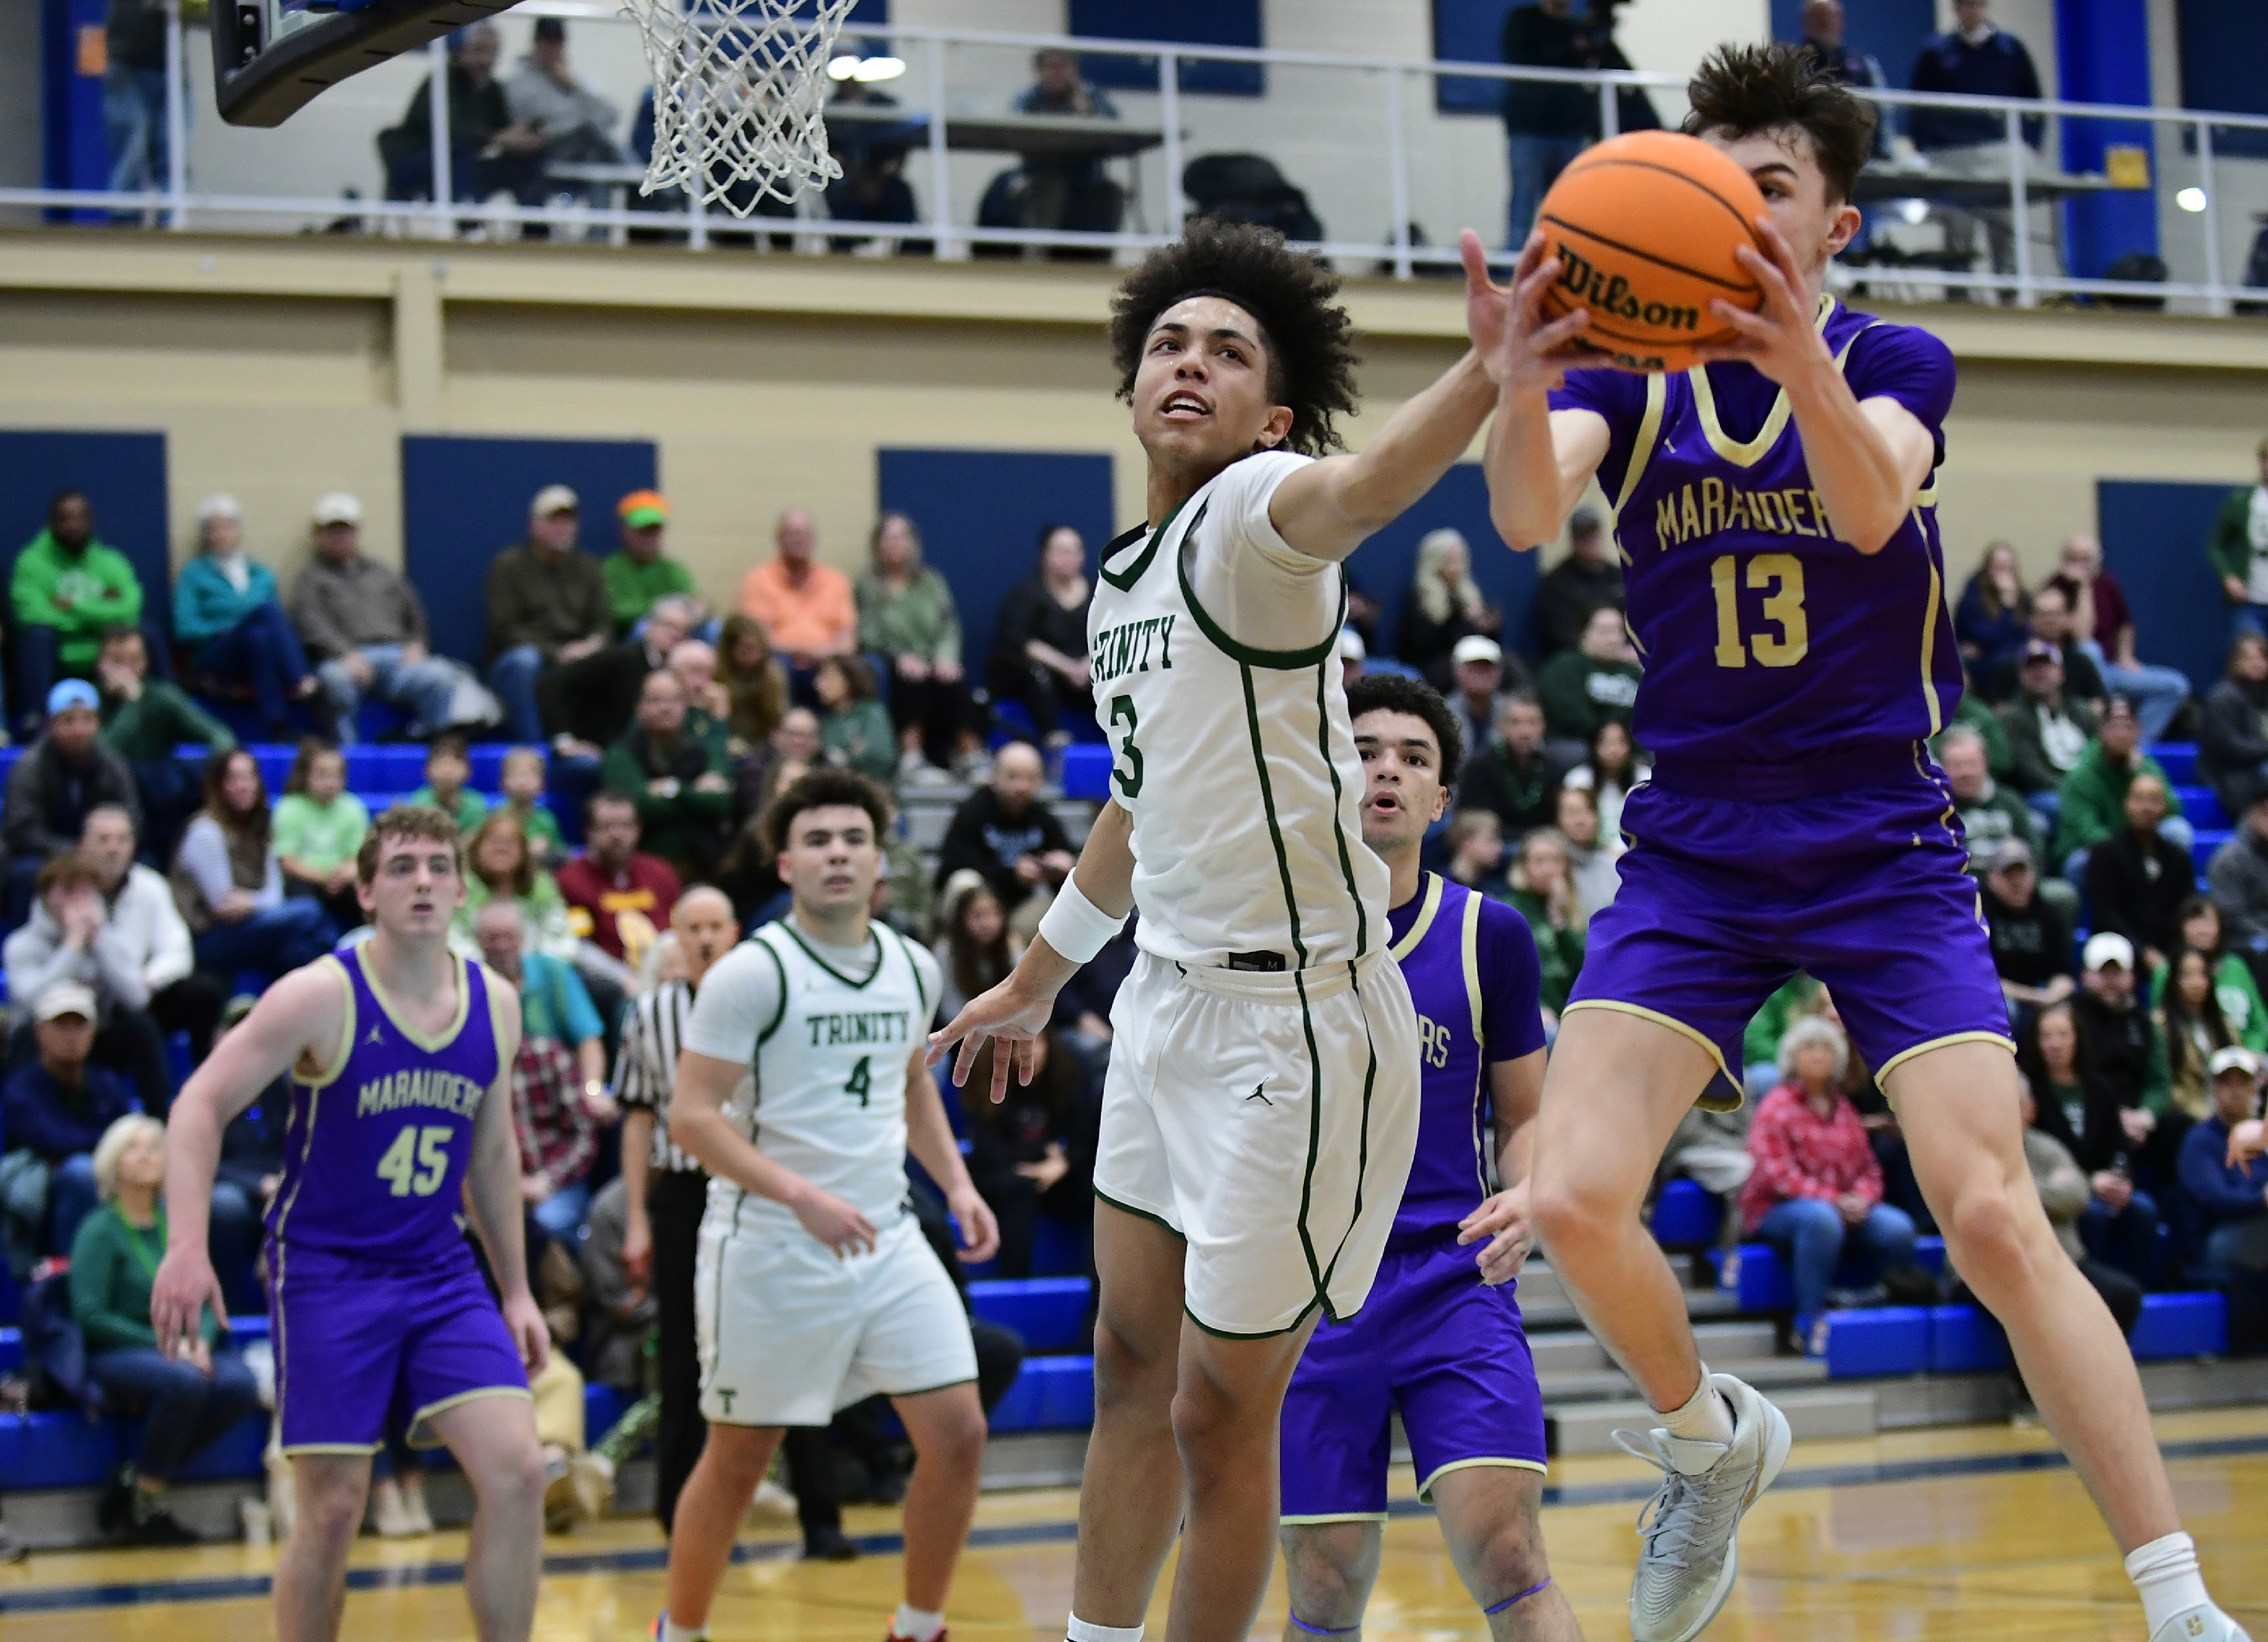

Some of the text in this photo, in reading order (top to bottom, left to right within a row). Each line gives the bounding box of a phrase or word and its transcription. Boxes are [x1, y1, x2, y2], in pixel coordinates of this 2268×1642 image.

[1558, 241, 1699, 331] Wilson
[1711, 553, 1809, 668] 13
[1110, 694, 1144, 798] 3
[1267, 960, 1278, 971] M
[806, 1011, 909, 1046] TRINITY
[844, 1055, 871, 1108] 4
[376, 1124, 454, 1197] 45
[716, 1388, 738, 1414] T
